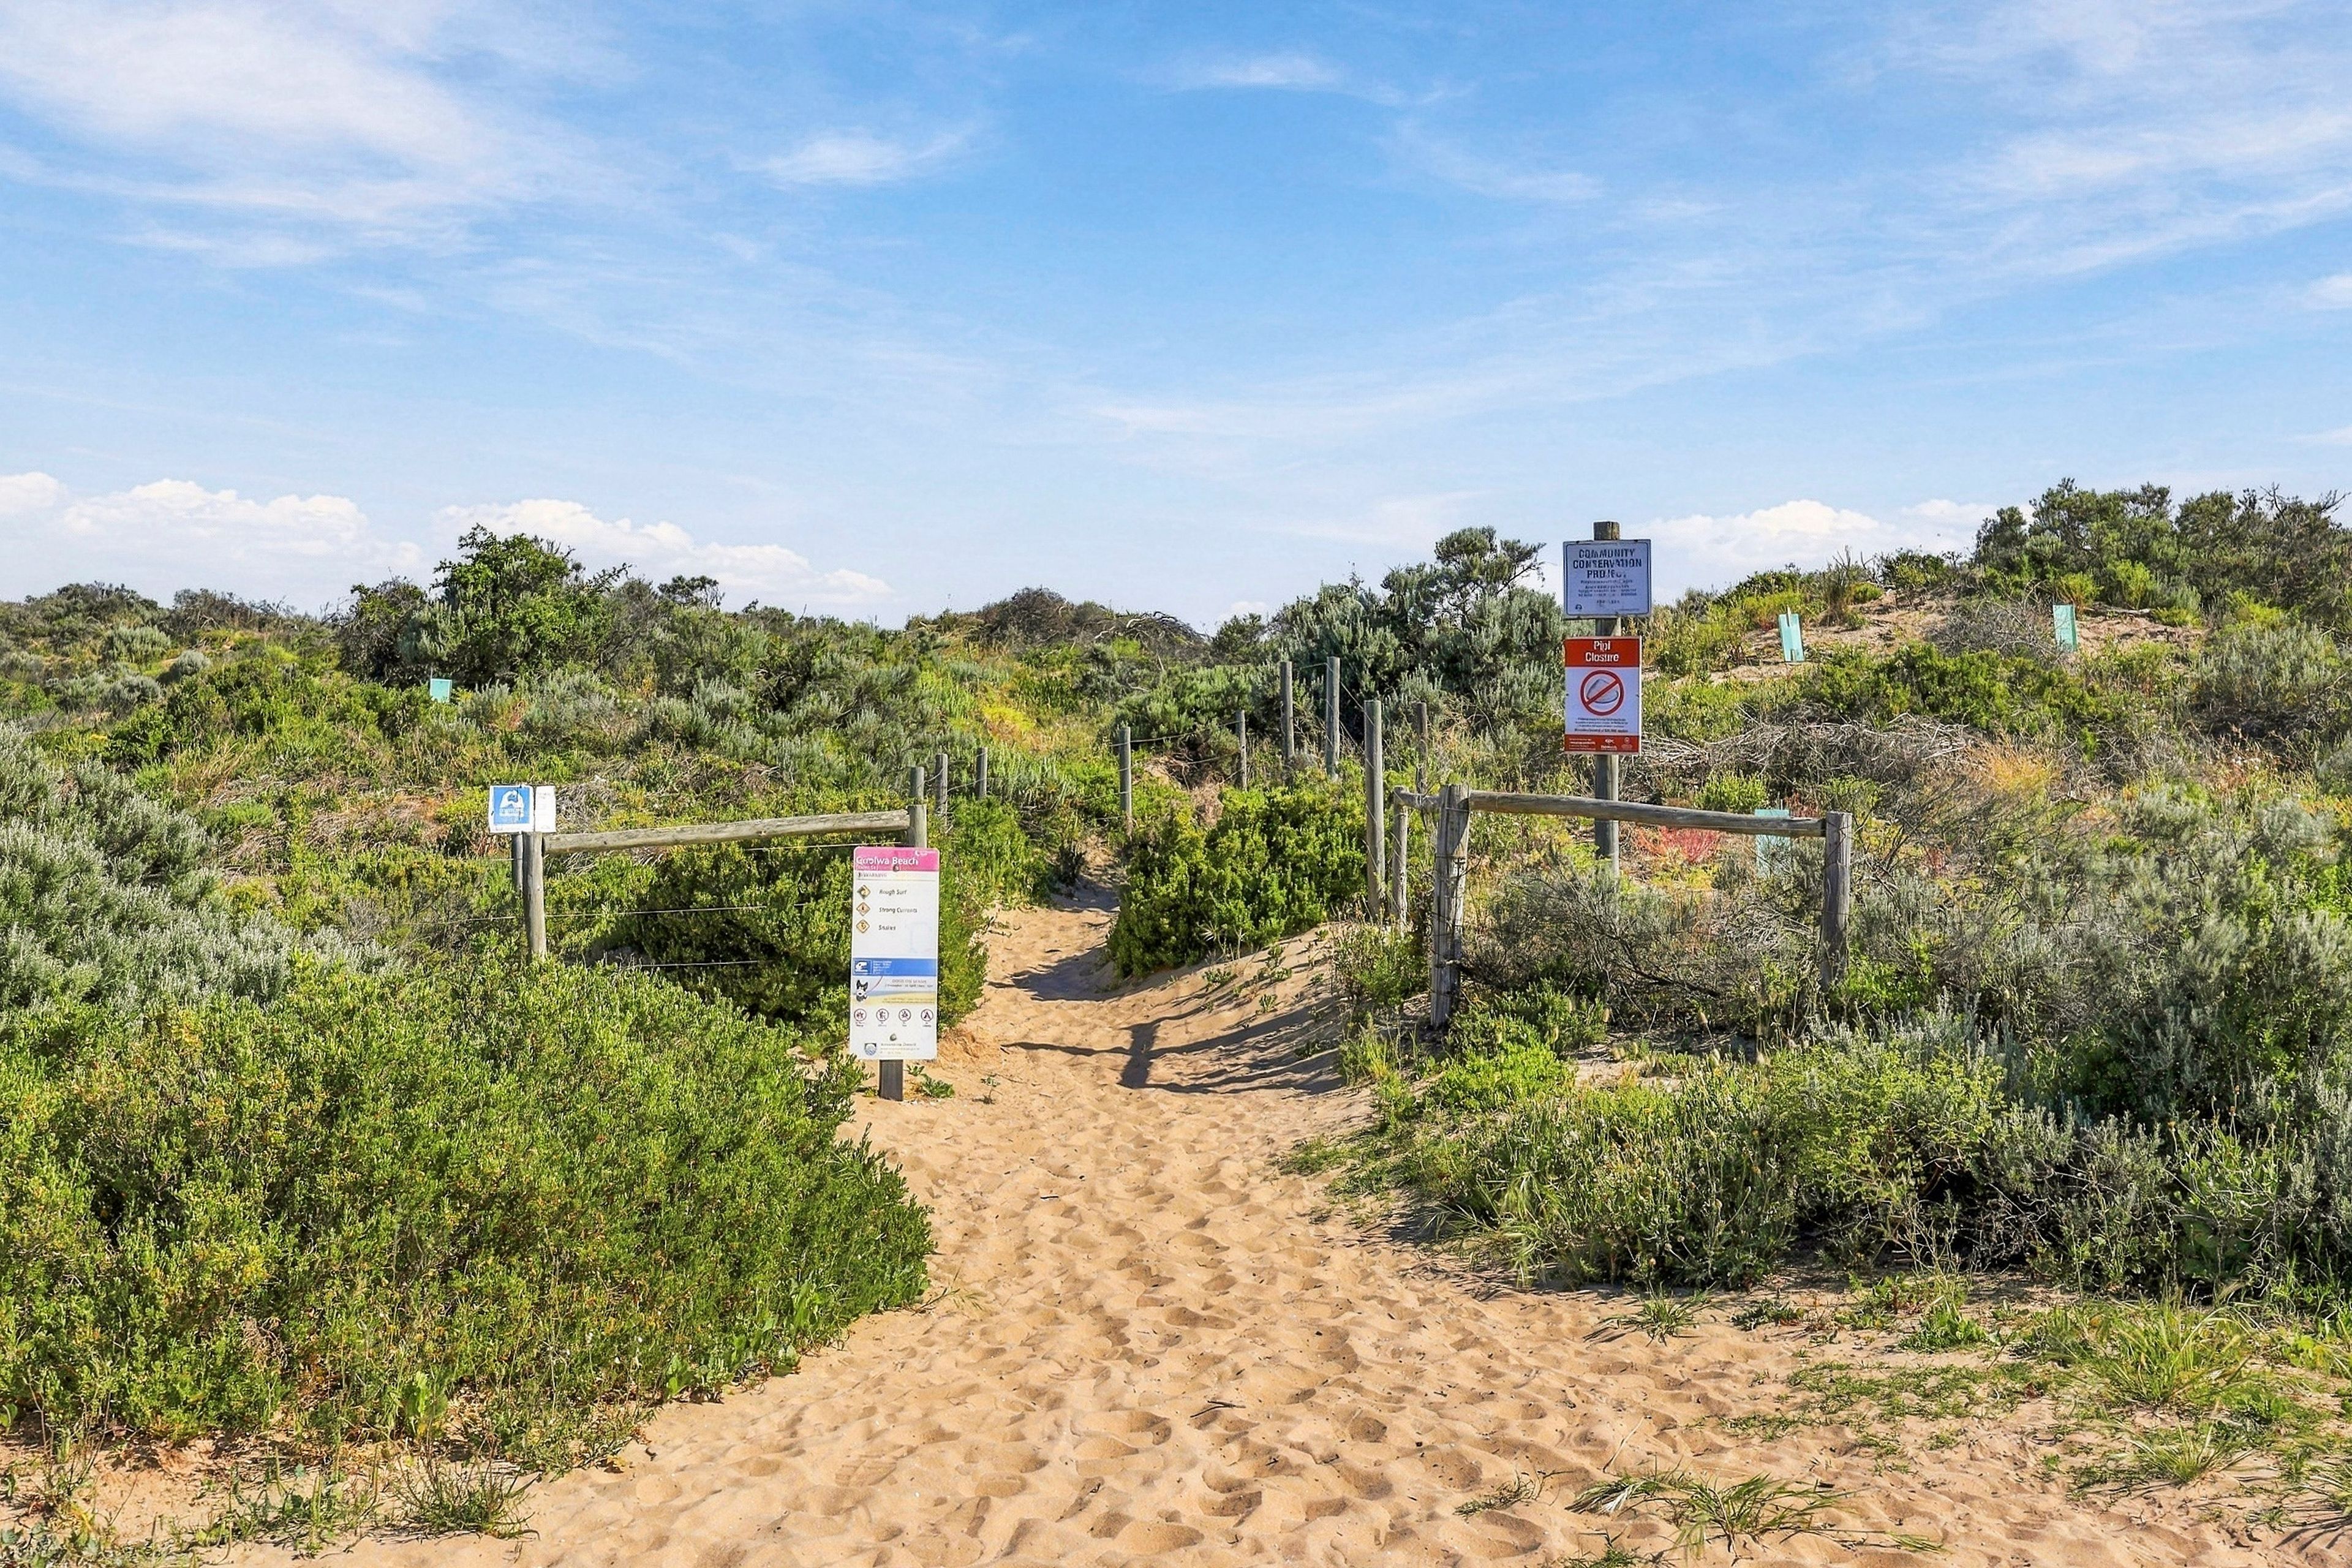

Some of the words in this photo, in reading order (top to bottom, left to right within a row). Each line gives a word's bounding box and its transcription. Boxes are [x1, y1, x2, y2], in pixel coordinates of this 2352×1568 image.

[1579, 548, 1635, 559] COMMUNITY
[1573, 558, 1642, 569] CONSERVATION
[1585, 652, 1619, 662] Closure
[856, 856, 889, 865] Goolwa
[892, 856, 918, 865] Beach
